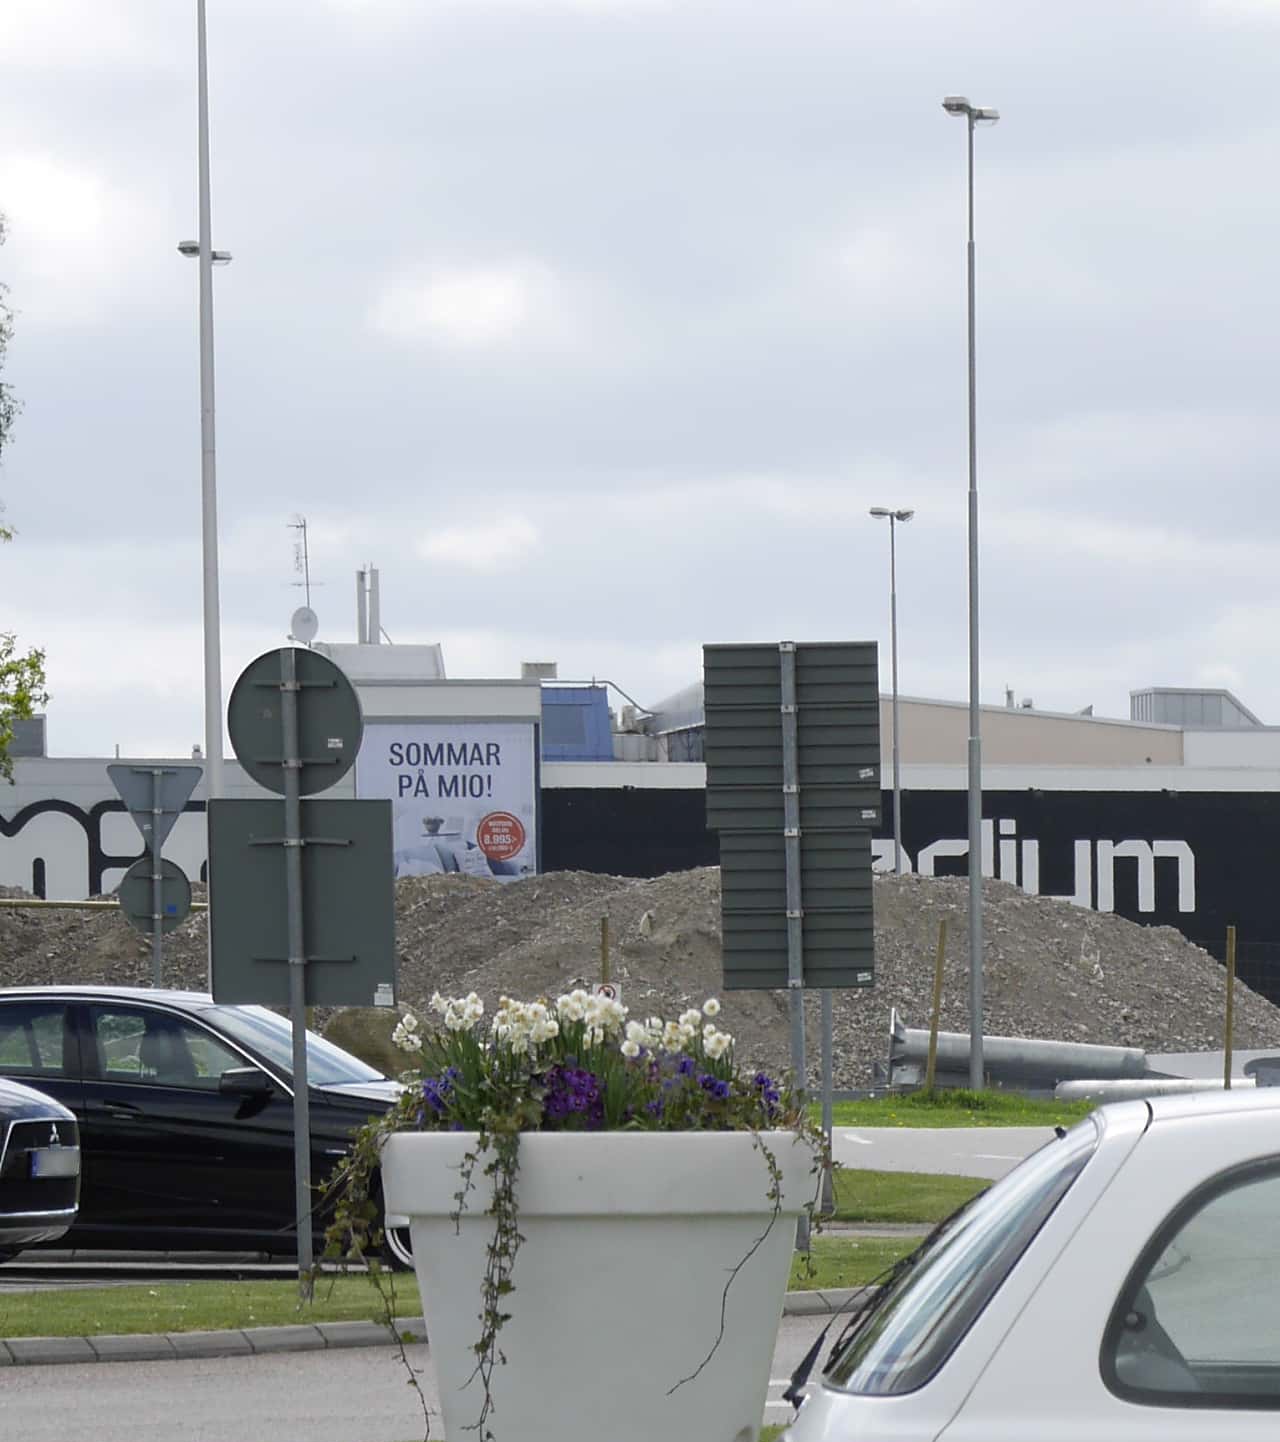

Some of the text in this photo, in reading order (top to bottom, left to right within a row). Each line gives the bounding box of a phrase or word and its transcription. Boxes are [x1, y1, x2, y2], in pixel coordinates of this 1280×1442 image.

[388, 742, 501, 766] SOMMAR
[398, 768, 492, 798] PÅ MIO!
